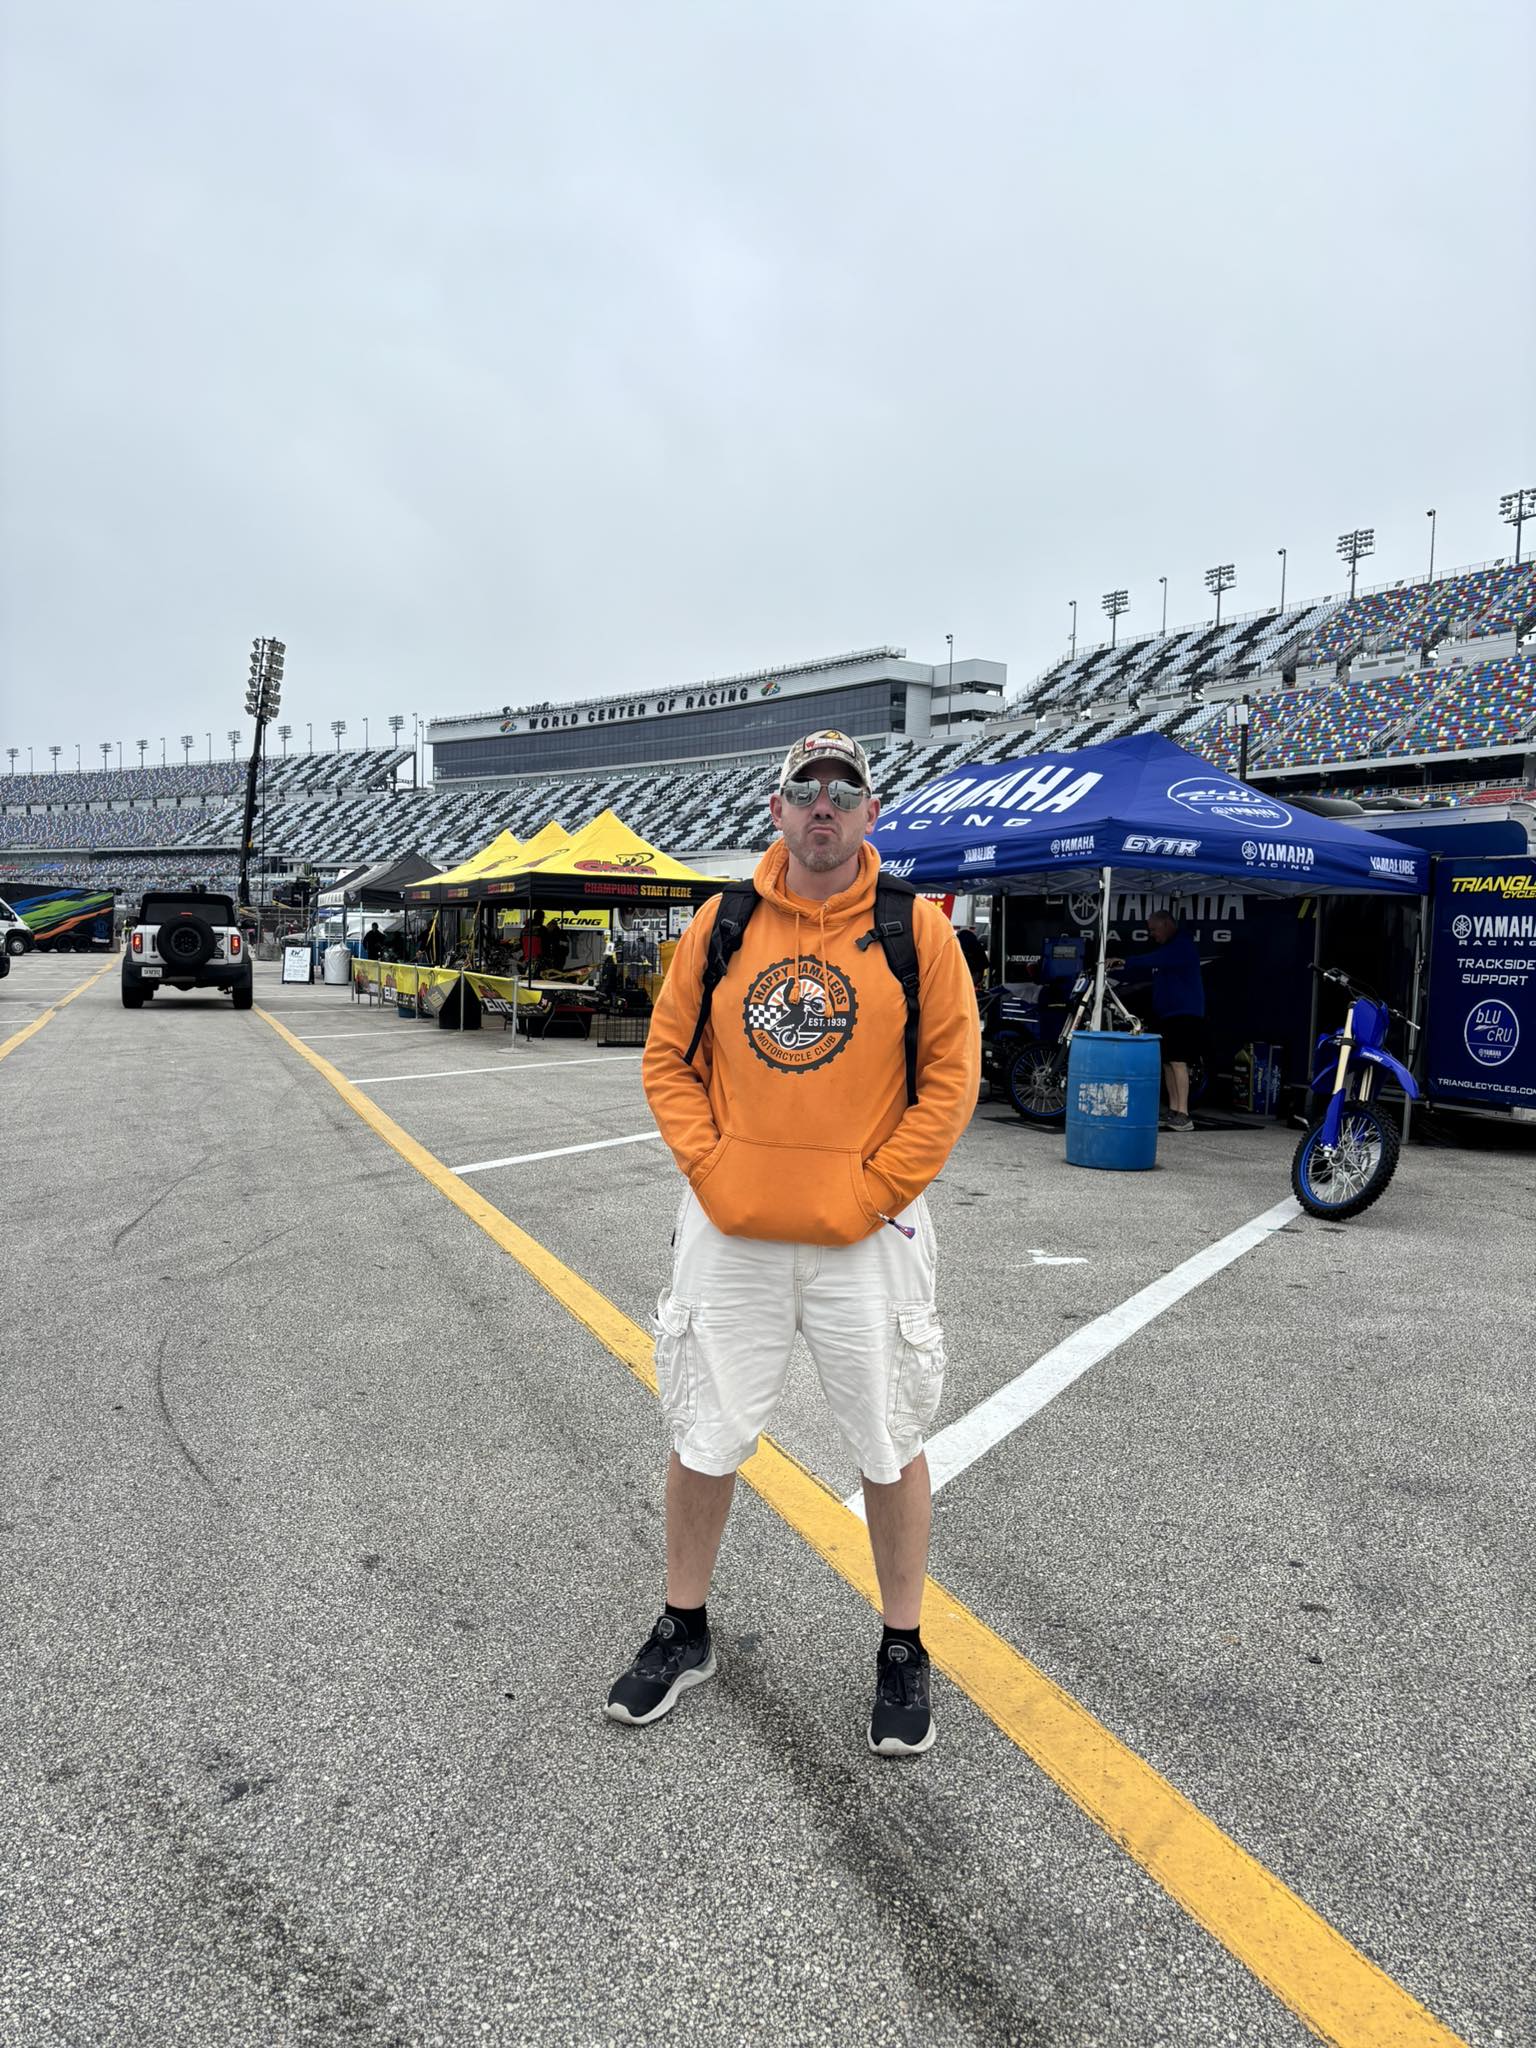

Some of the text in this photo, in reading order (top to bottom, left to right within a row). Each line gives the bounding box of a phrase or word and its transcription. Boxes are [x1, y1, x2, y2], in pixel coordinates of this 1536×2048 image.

[529, 687, 748, 729] WORLD CENTER OF RACING
[901, 766, 1103, 814] YAMAHA
[878, 814, 1032, 831] ACING
[1059, 836, 1094, 851] YAMAHA
[1121, 834, 1201, 857] GYTR
[1258, 842, 1314, 865] YAMAHA
[1246, 861, 1311, 871] RACING
[1370, 856, 1416, 875] YAMALUBE
[583, 882, 692, 898] CHAMPIONS START HERE
[1452, 875, 1536, 892] TRIANGL
[1503, 890, 1536, 898] CYCLE
[1473, 916, 1536, 938] YAMAH
[1457, 959, 1536, 970] TRACKSIDE
[754, 967, 788, 1000] HAPPY
[1462, 974, 1528, 985] SUPPORT
[808, 1018, 847, 1027] EST. 1939
[757, 1032, 836, 1062] MOTORCYCLE CLUB
[1438, 1078, 1536, 1095] TRIANGLECYCLES.CO
